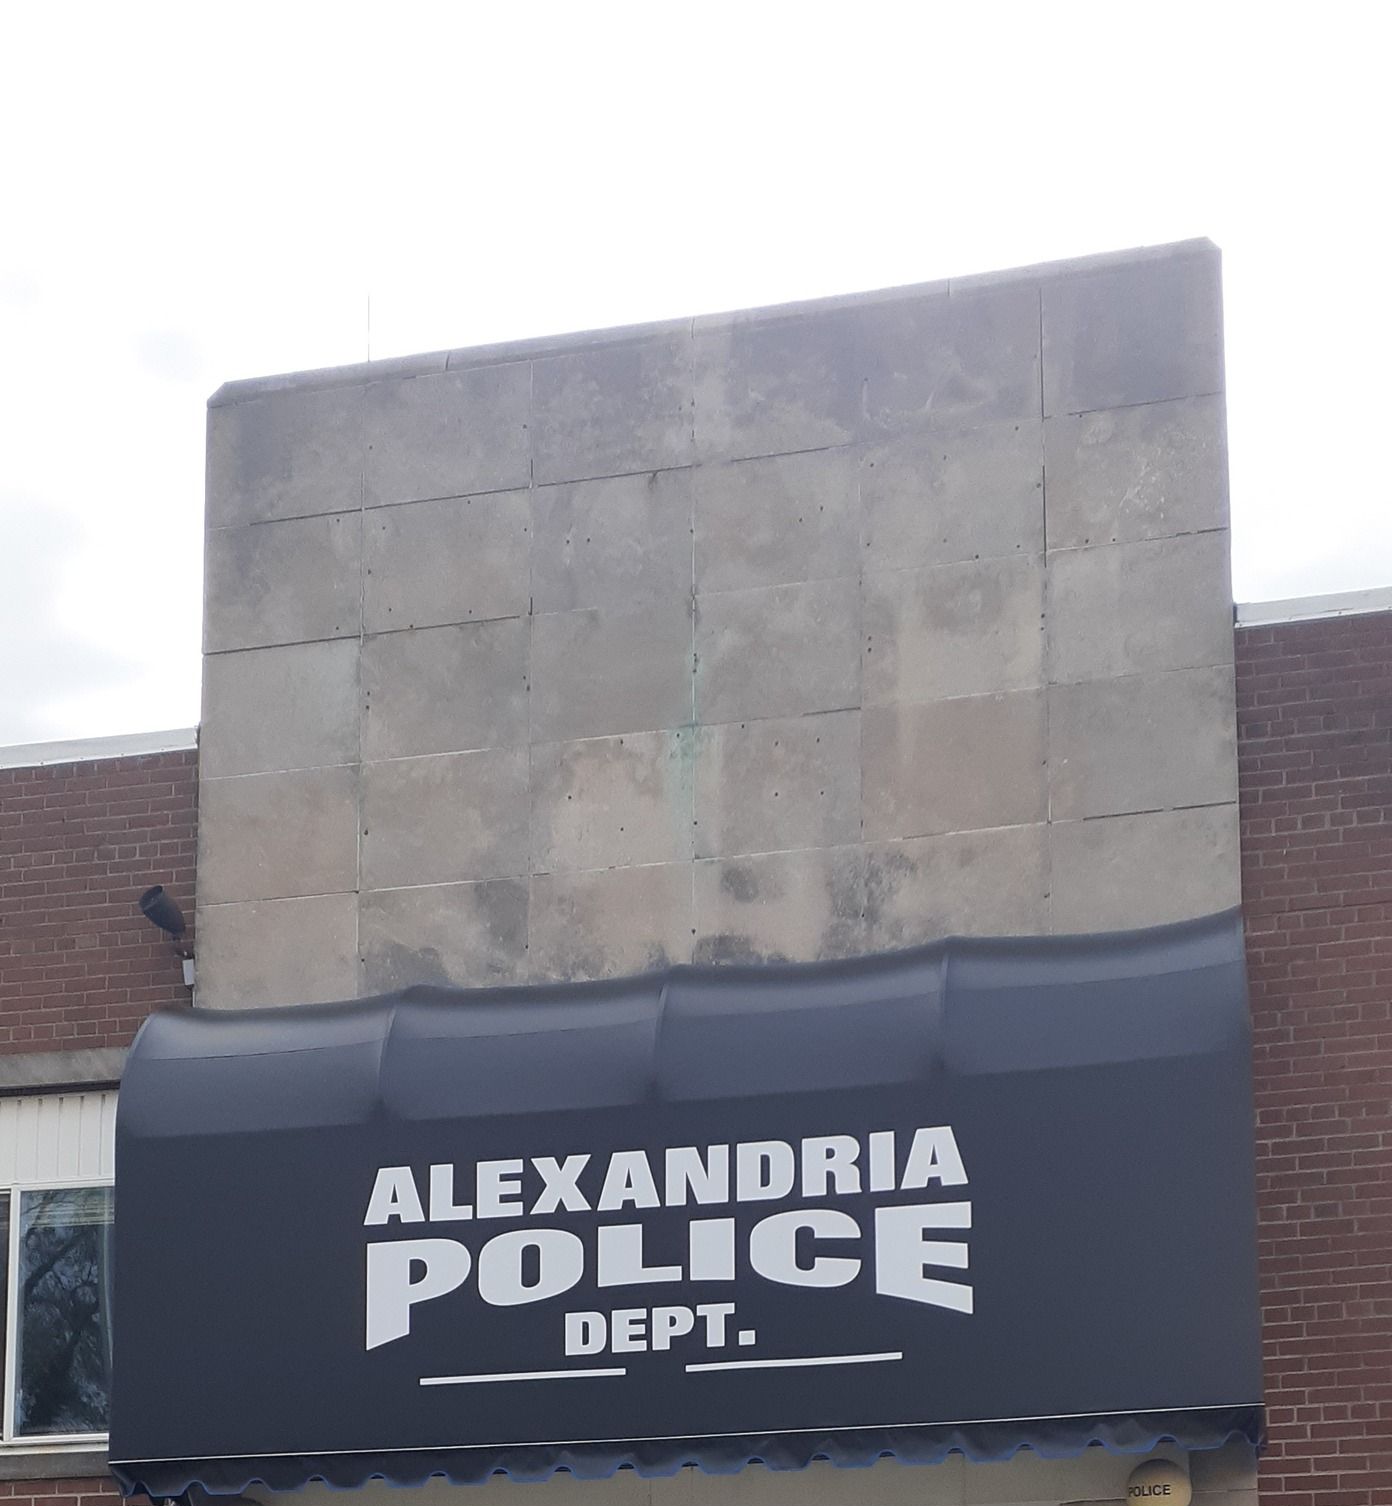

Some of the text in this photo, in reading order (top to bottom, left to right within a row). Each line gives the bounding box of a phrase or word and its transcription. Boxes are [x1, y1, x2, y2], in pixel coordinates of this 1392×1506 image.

[364, 1125, 969, 1226] ALEXANDRIA
[366, 1201, 974, 1351] POLICE
[565, 1302, 756, 1356] DEPT.
[1128, 1485, 1171, 1497] POLICE
